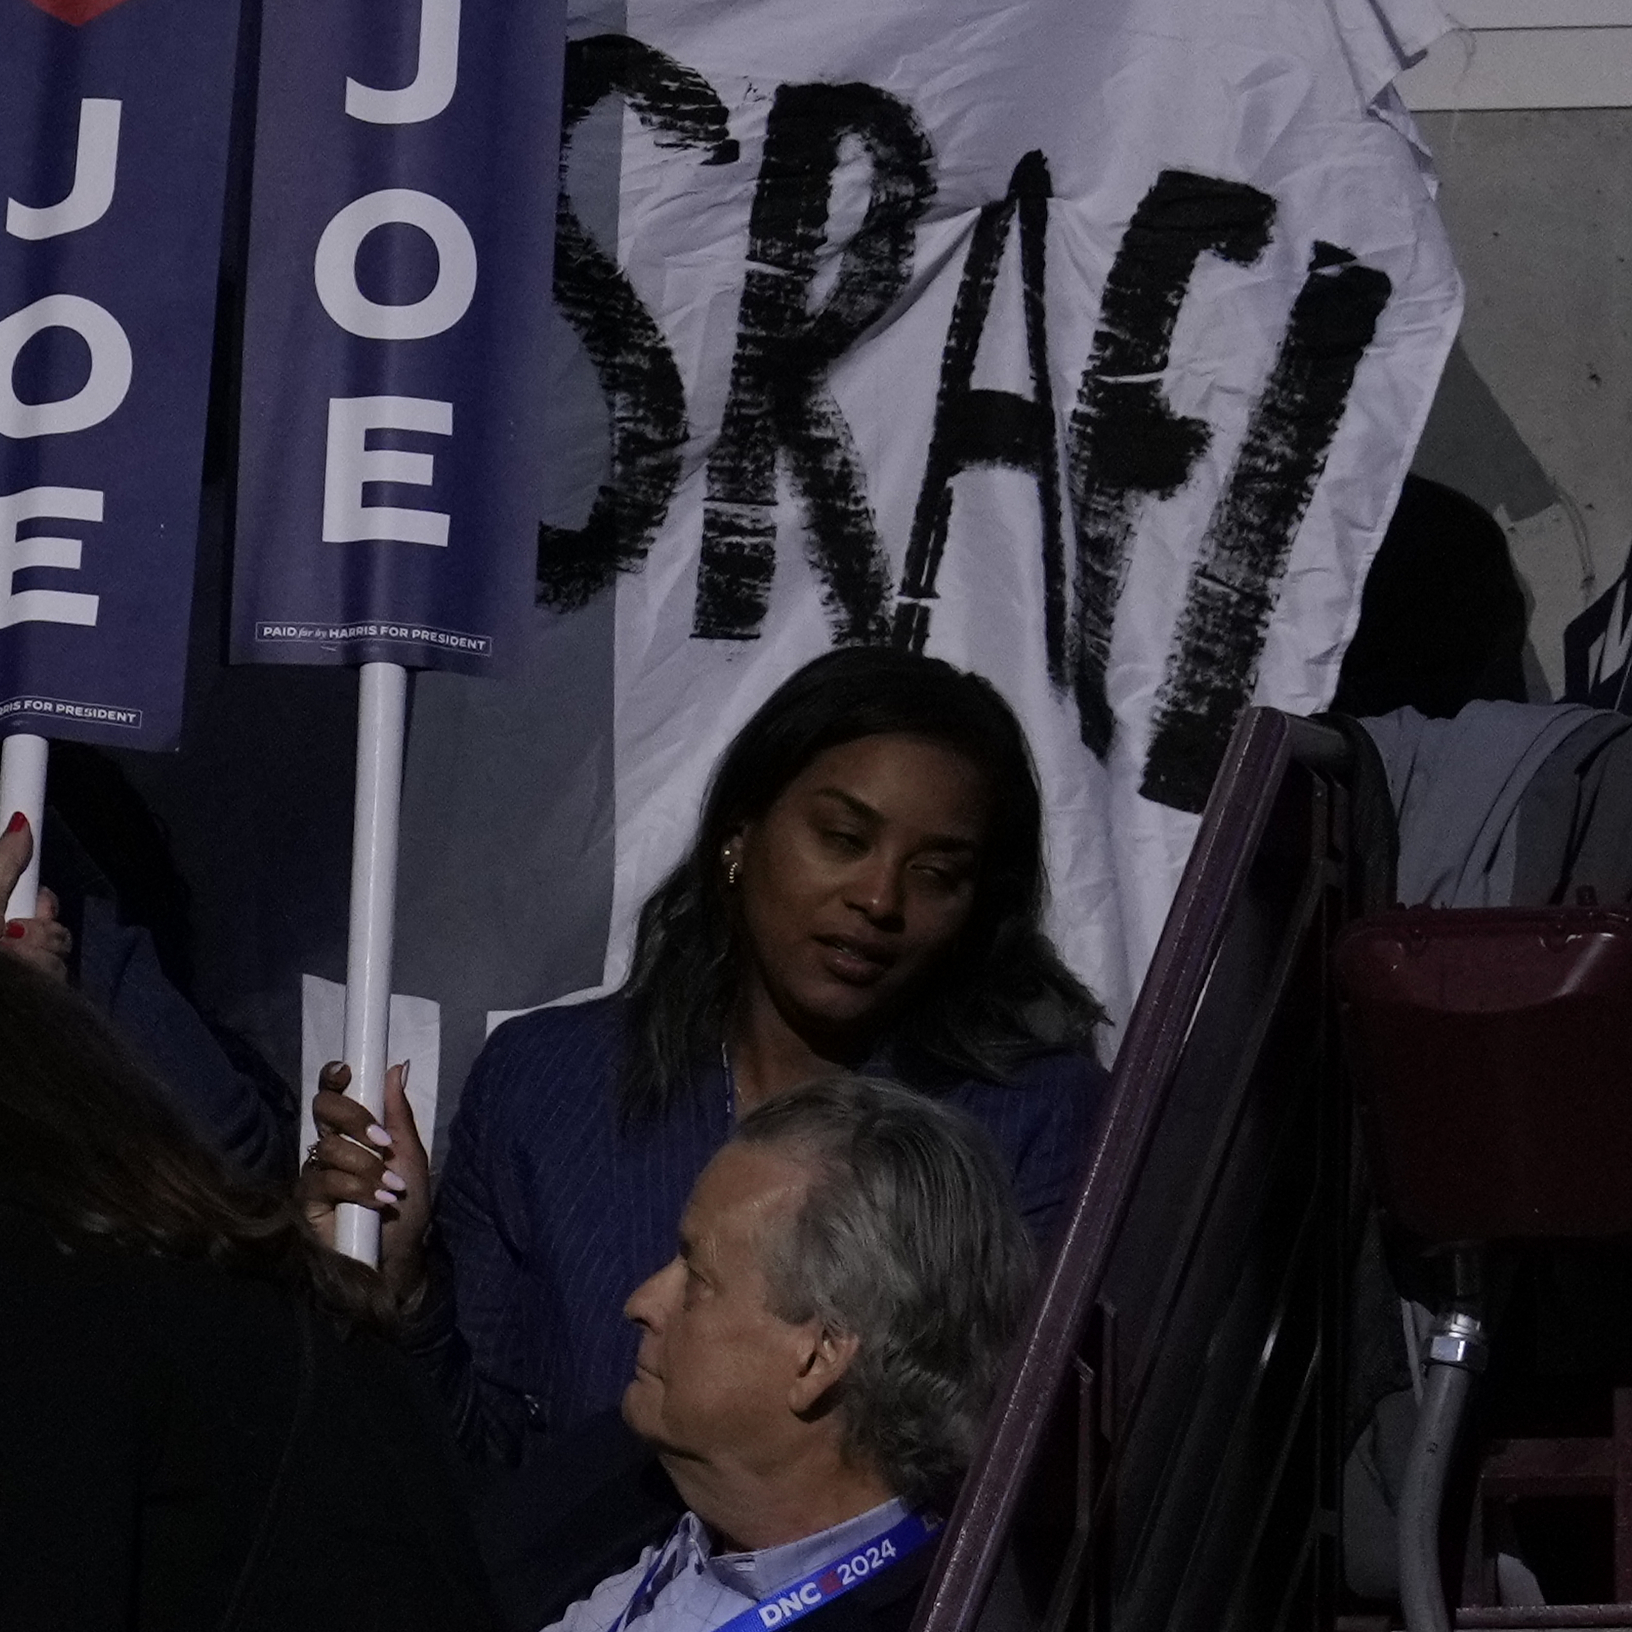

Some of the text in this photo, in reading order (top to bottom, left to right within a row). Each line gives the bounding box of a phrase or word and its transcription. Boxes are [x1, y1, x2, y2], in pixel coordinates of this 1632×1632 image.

[263, 626, 297, 638] PAID
[329, 625, 378, 639] HARRIS
[379, 625, 410, 639] FOR
[411, 628, 487, 651] PRESIDENT
[23, 698, 53, 713] FOR
[55, 704, 137, 724] PRESIDENT
[758, 1538, 898, 1628] DNC 2024
